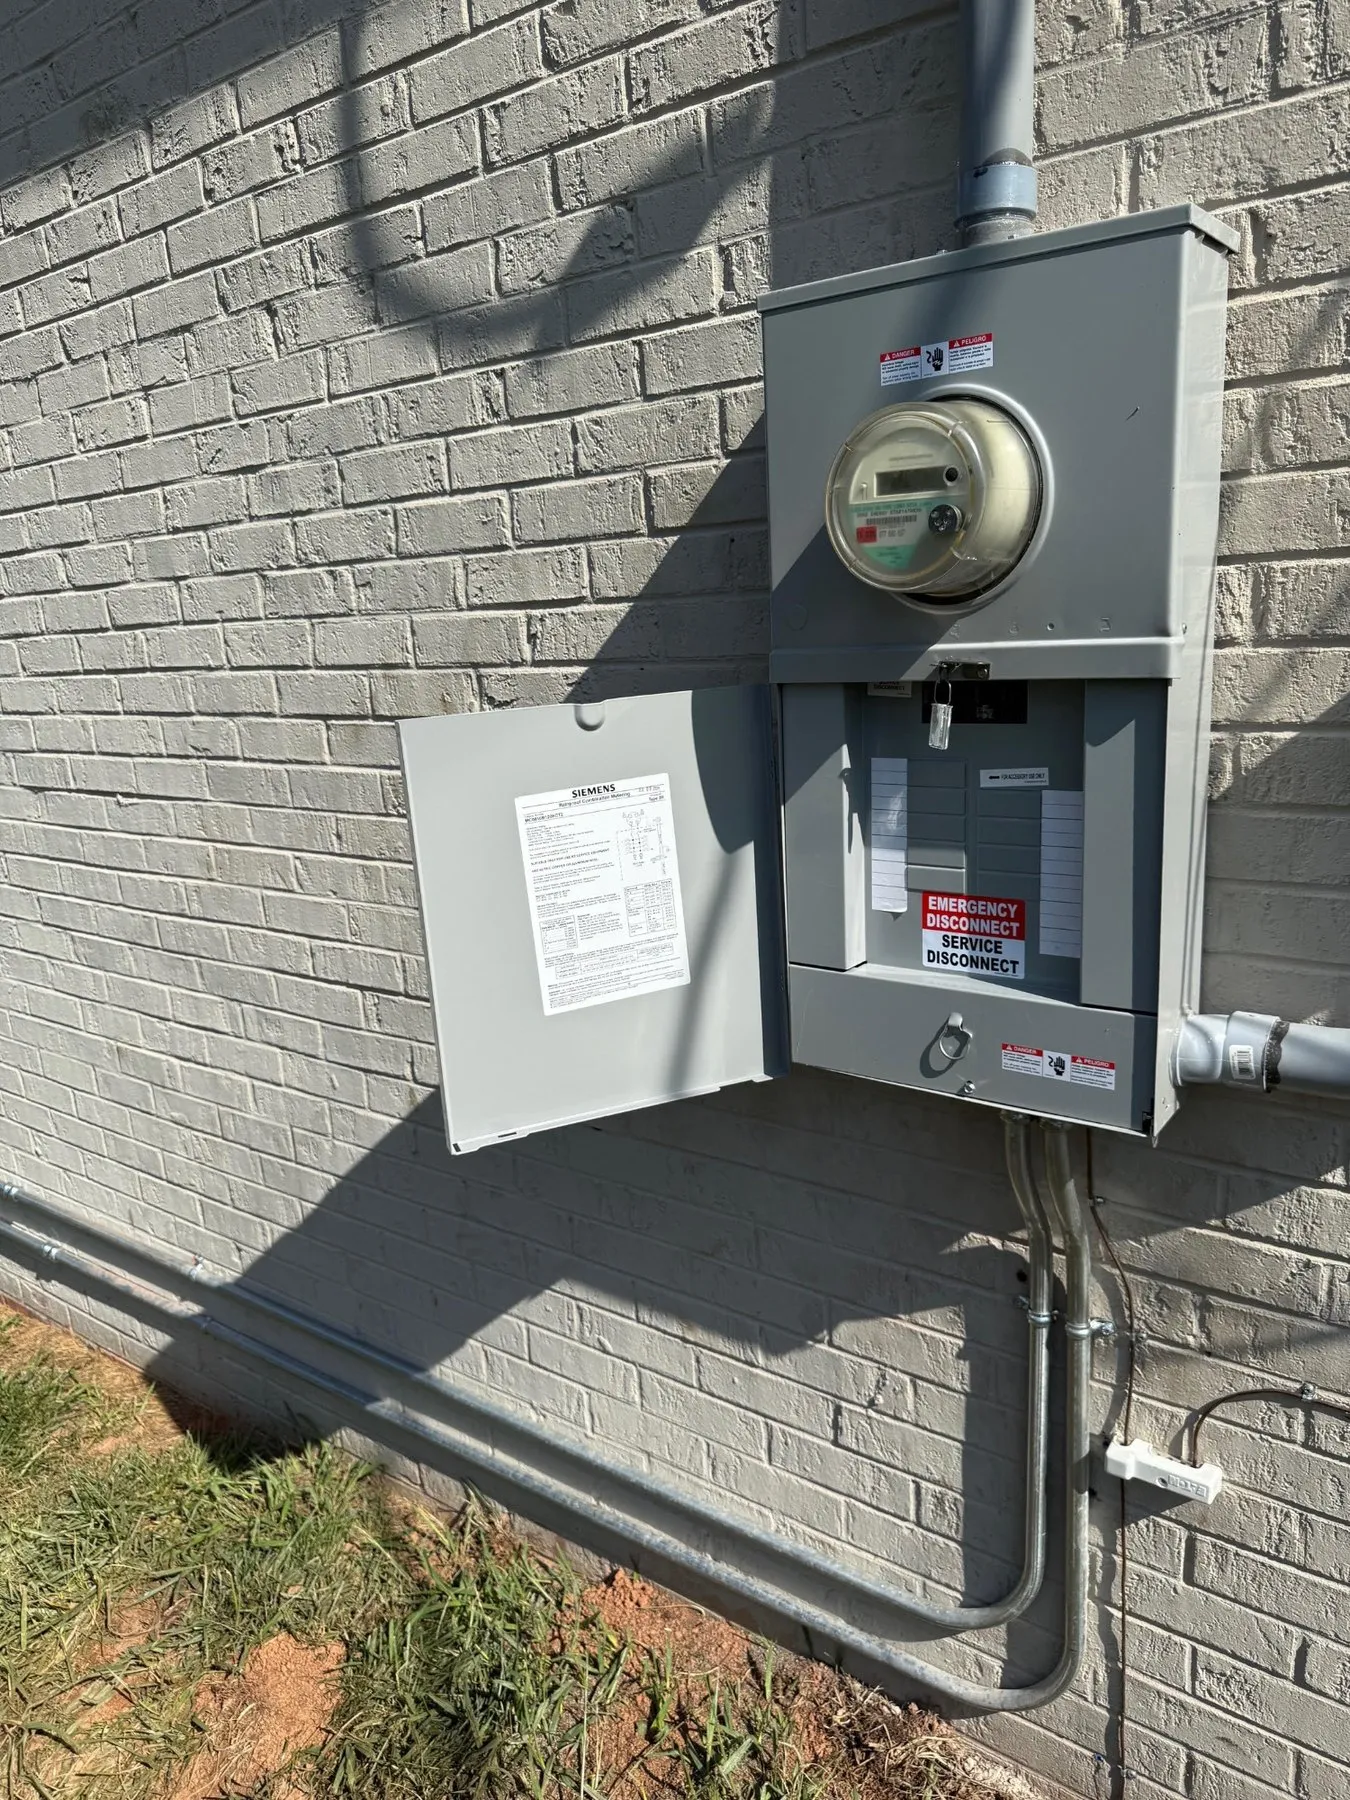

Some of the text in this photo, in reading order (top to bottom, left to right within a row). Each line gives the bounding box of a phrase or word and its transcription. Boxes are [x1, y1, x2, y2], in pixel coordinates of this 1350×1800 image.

[961, 335, 987, 345] PELIGRO
[891, 349, 915, 359] DANGER
[572, 784, 616, 799] SIEMENS
[928, 895, 1018, 918] EMERGENCY
[926, 913, 1020, 937] DISCONNECT
[942, 934, 1003, 955] SERVICE
[927, 949, 1020, 974] DISCONNECT
[1013, 1046, 1037, 1055] DANGER
[1083, 1058, 1110, 1068] PELIGRO
